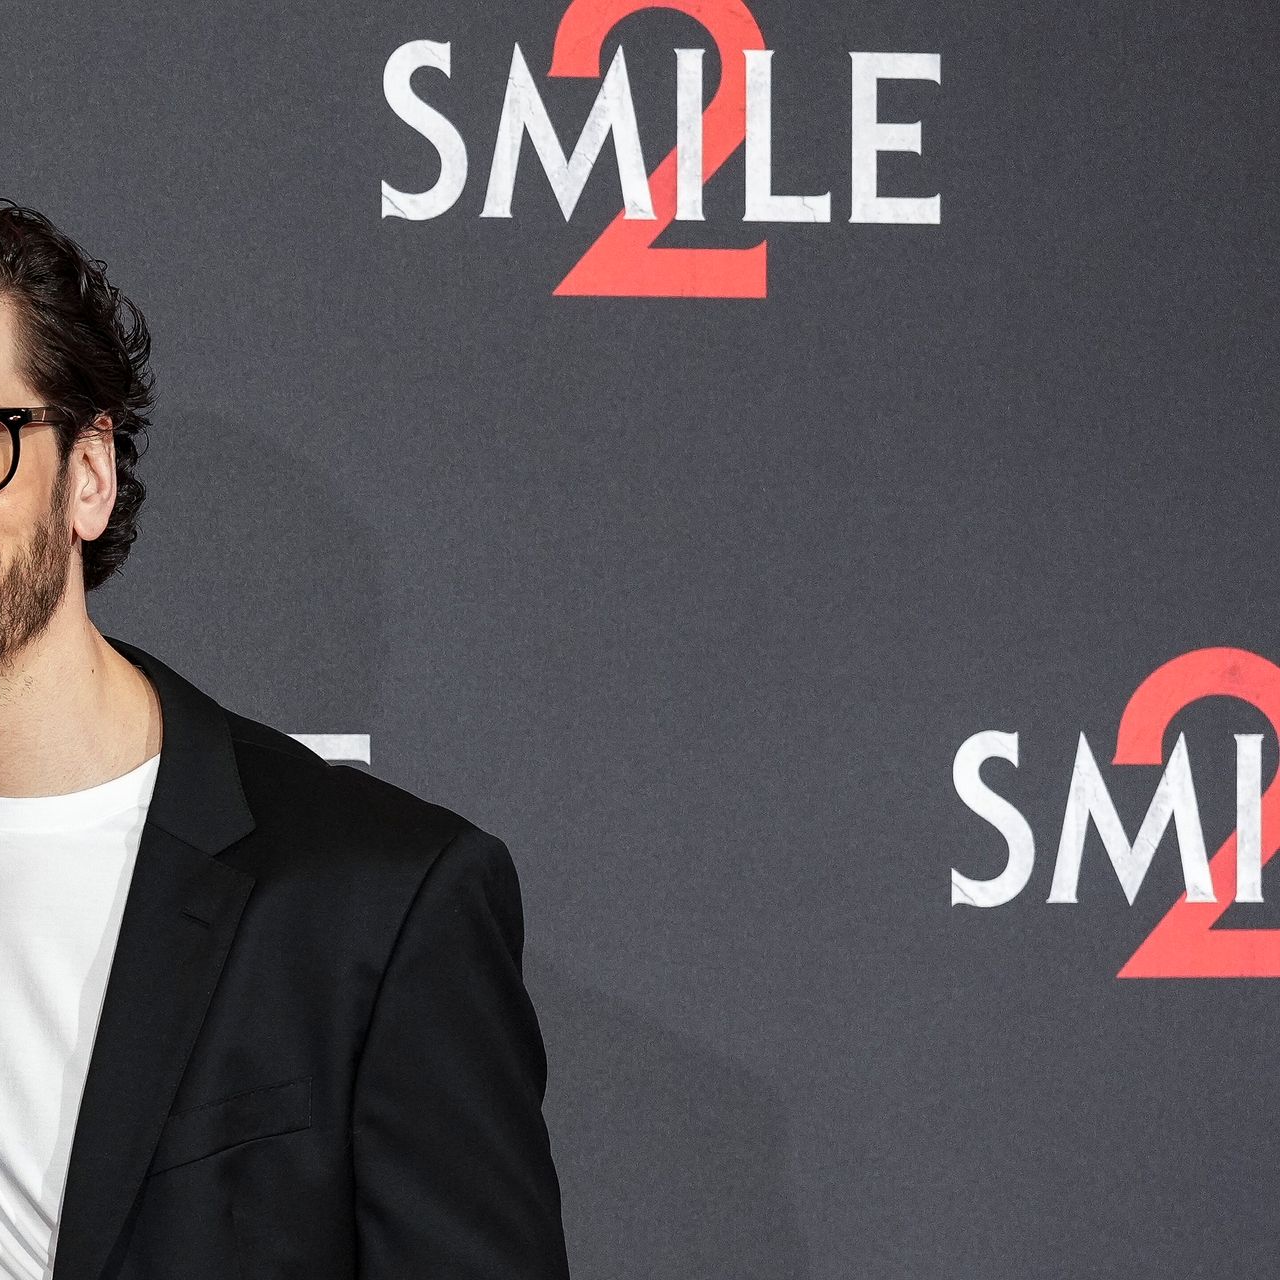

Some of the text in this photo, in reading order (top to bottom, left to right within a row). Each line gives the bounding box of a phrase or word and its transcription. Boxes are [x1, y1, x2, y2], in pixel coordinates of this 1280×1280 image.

[381, 0, 942, 299] SMILE 2
[1112, 646, 1280, 979] 2
